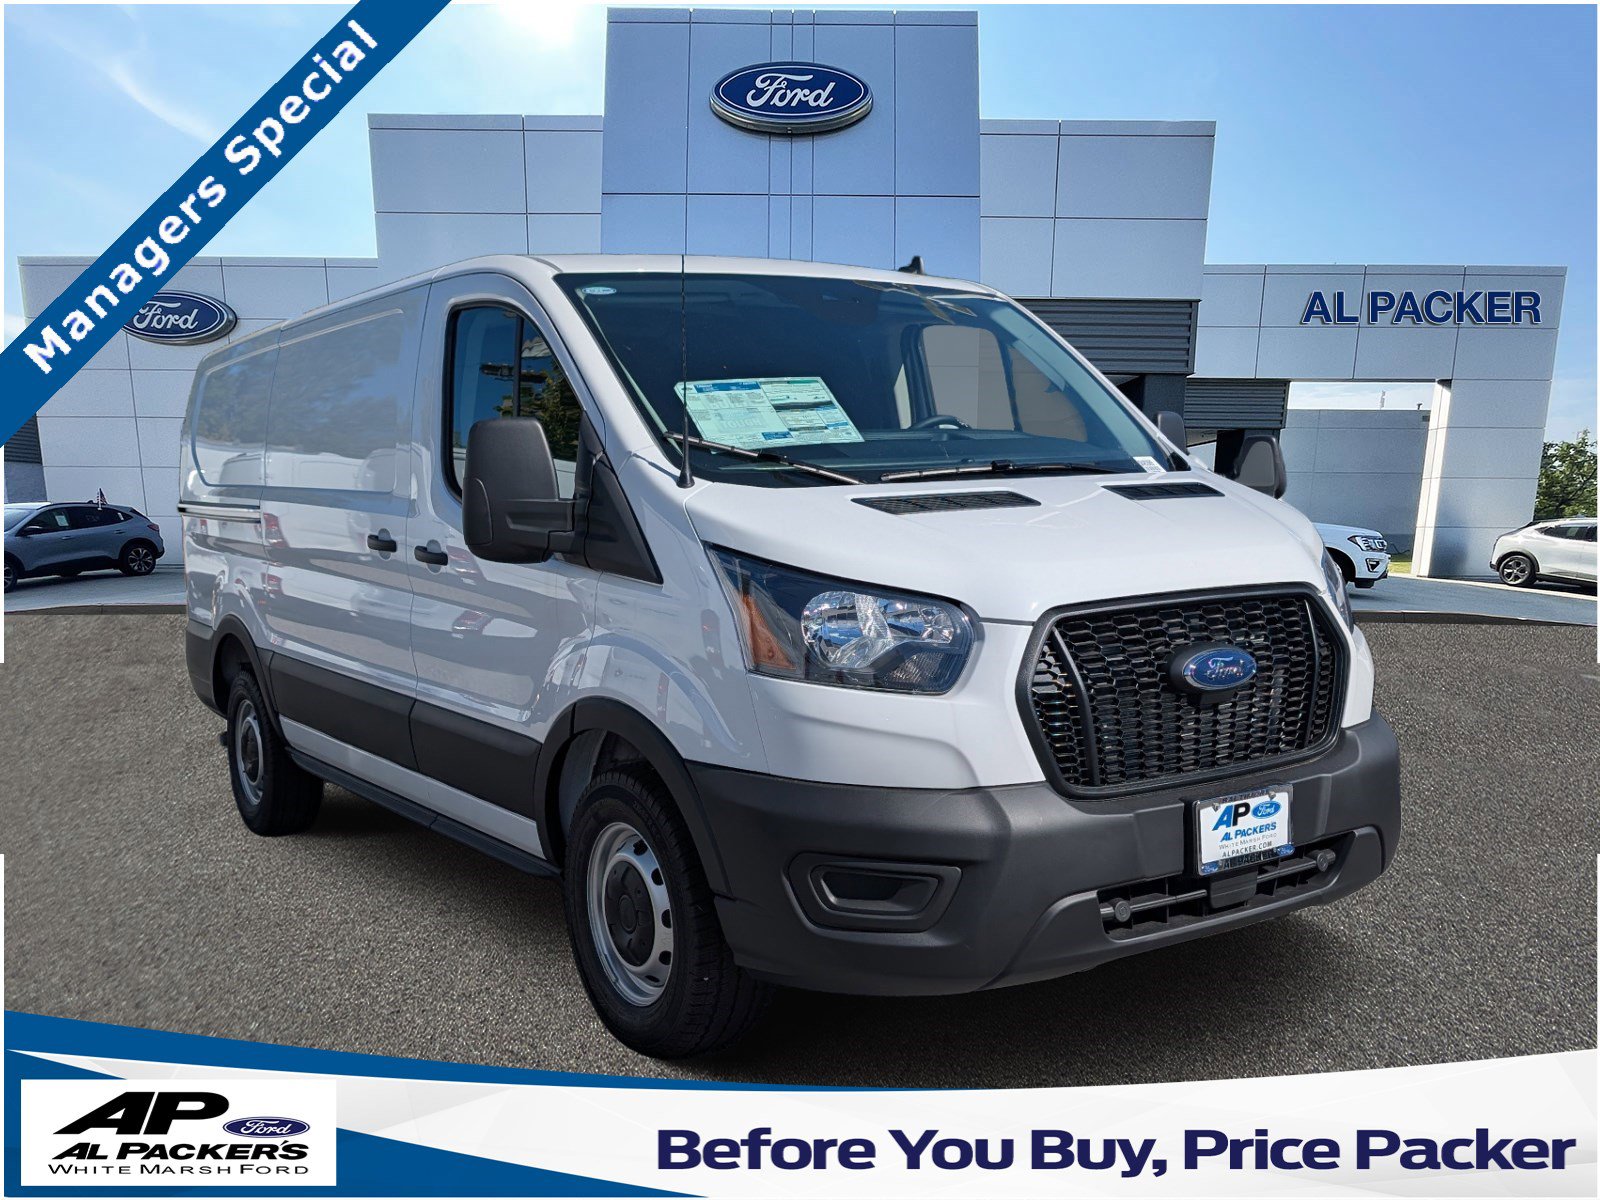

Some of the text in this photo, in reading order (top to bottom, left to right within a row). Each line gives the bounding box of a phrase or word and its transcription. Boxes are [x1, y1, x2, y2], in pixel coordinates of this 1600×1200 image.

[746, 73, 836, 107] Ford
[133, 301, 199, 329] Ford
[1301, 289, 1542, 325] AL PACKER
[1206, 656, 1244, 679] Ford
[1212, 802, 1276, 831] AP Ford
[1220, 831, 1233, 842] AL
[1222, 841, 1273, 858] ALPACKER.COM
